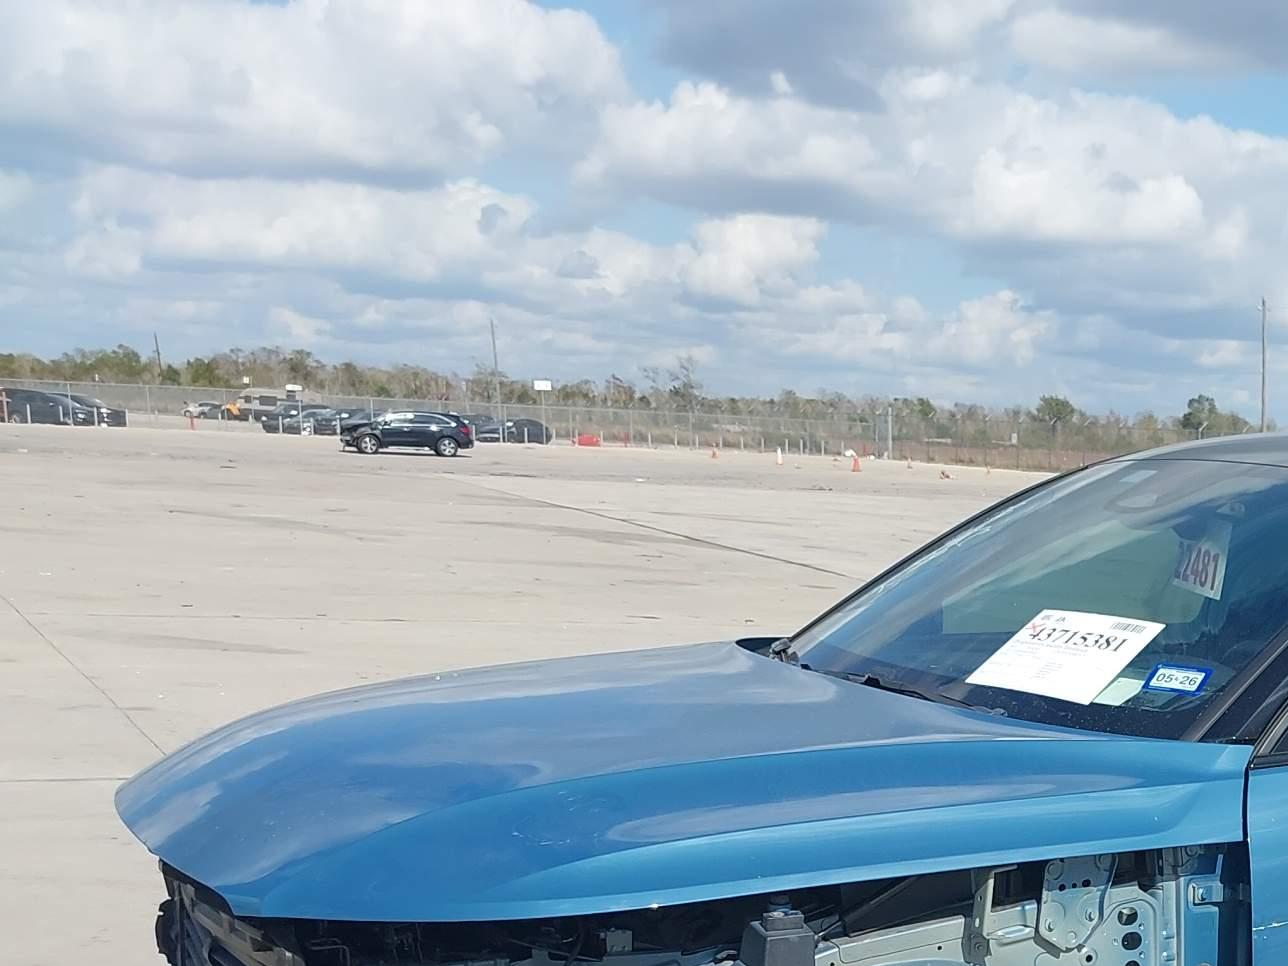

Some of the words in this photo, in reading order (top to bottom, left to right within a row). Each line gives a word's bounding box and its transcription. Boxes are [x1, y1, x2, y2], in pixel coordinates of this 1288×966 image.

[1028, 626, 1129, 652] 43715381
[1156, 673, 1175, 684] 05
[1179, 675, 1199, 687] 26
